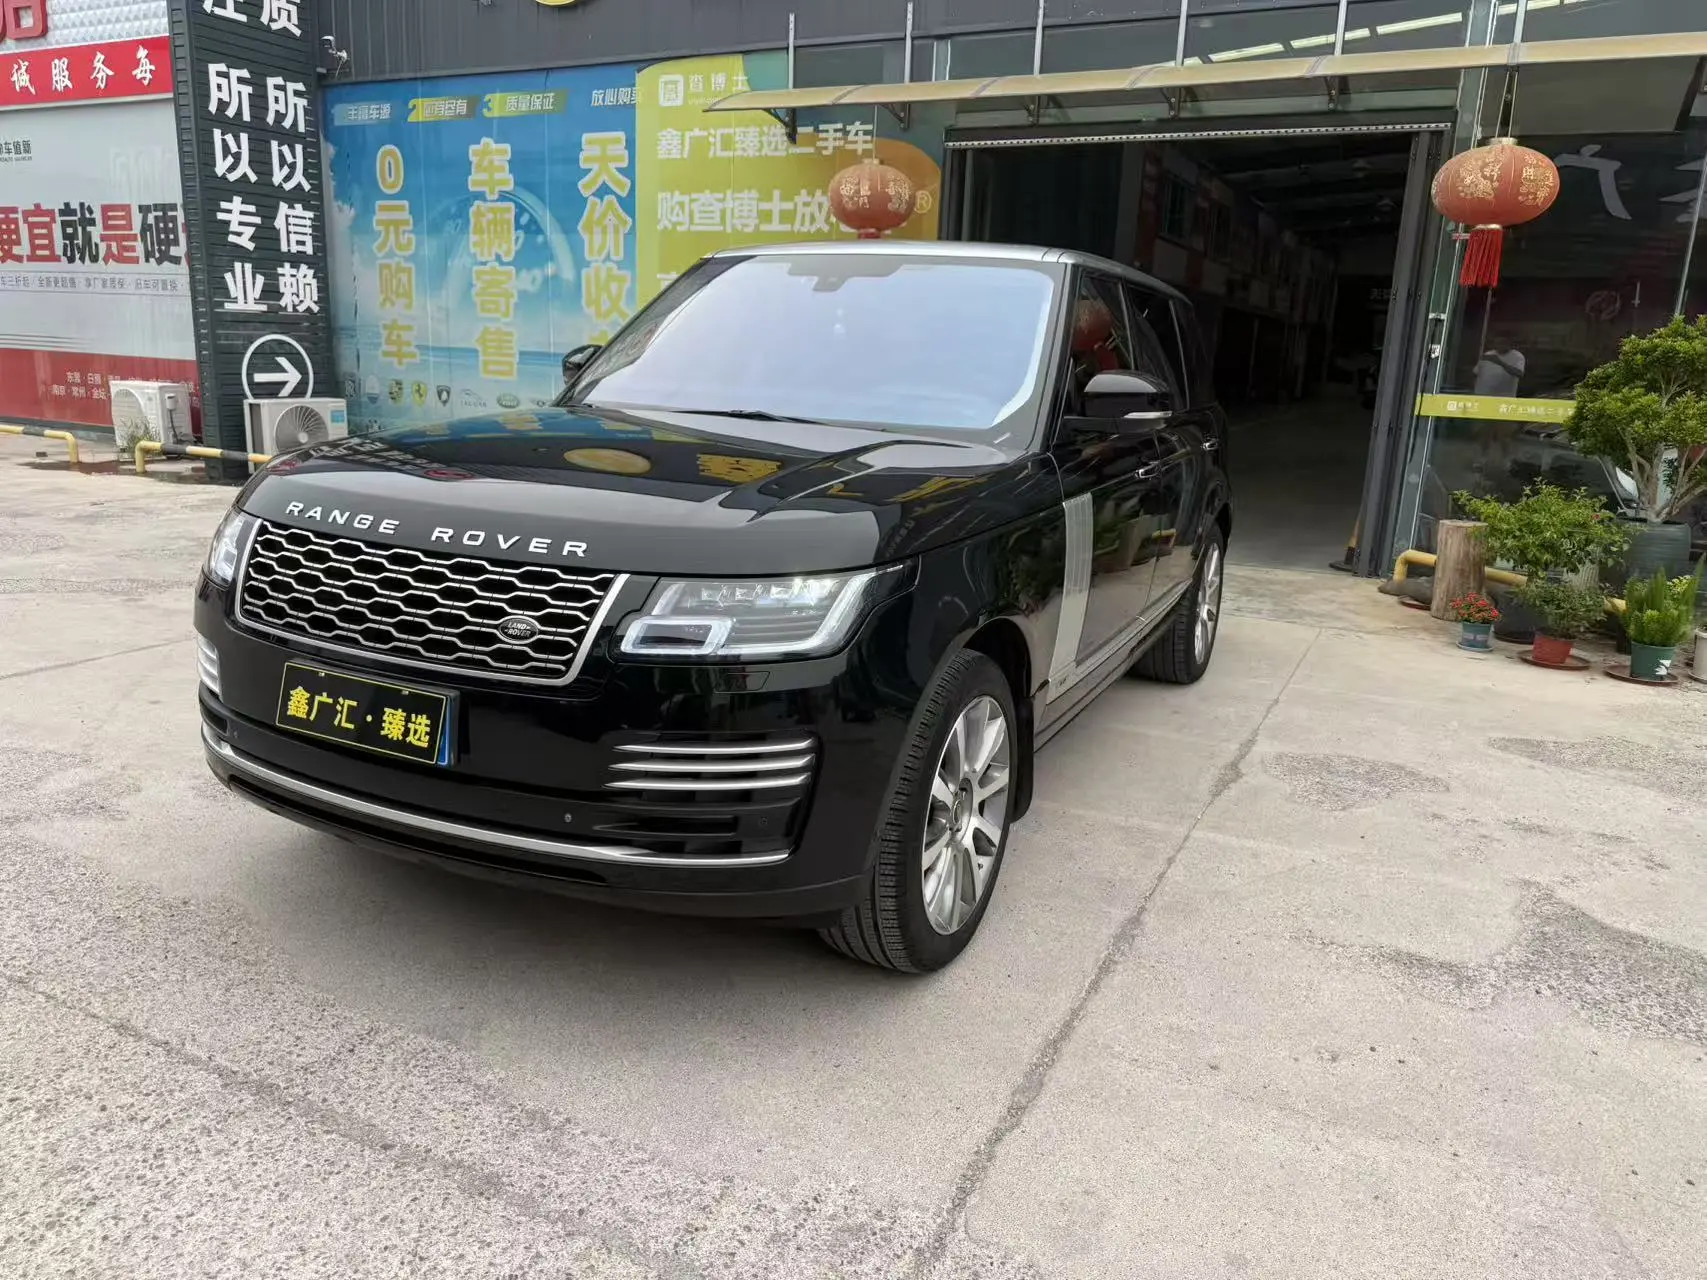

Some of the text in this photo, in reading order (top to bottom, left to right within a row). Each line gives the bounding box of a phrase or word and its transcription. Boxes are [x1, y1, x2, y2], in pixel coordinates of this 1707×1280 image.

[505, 92, 554, 113] 质量保证
[657, 121, 873, 159] 鑫广汇臻选二手车
[0, 201, 190, 266] 便宜就是硬
[208, 63, 268, 312] 所以专业
[266, 76, 320, 313] 所以信赖
[372, 144, 420, 368] 0元购车
[577, 131, 632, 346] 天价收
[468, 136, 519, 381] 车辆寄售
[285, 500, 588, 557] RANGE ROVER
[286, 685, 431, 748] 鑫广汇·臻选
